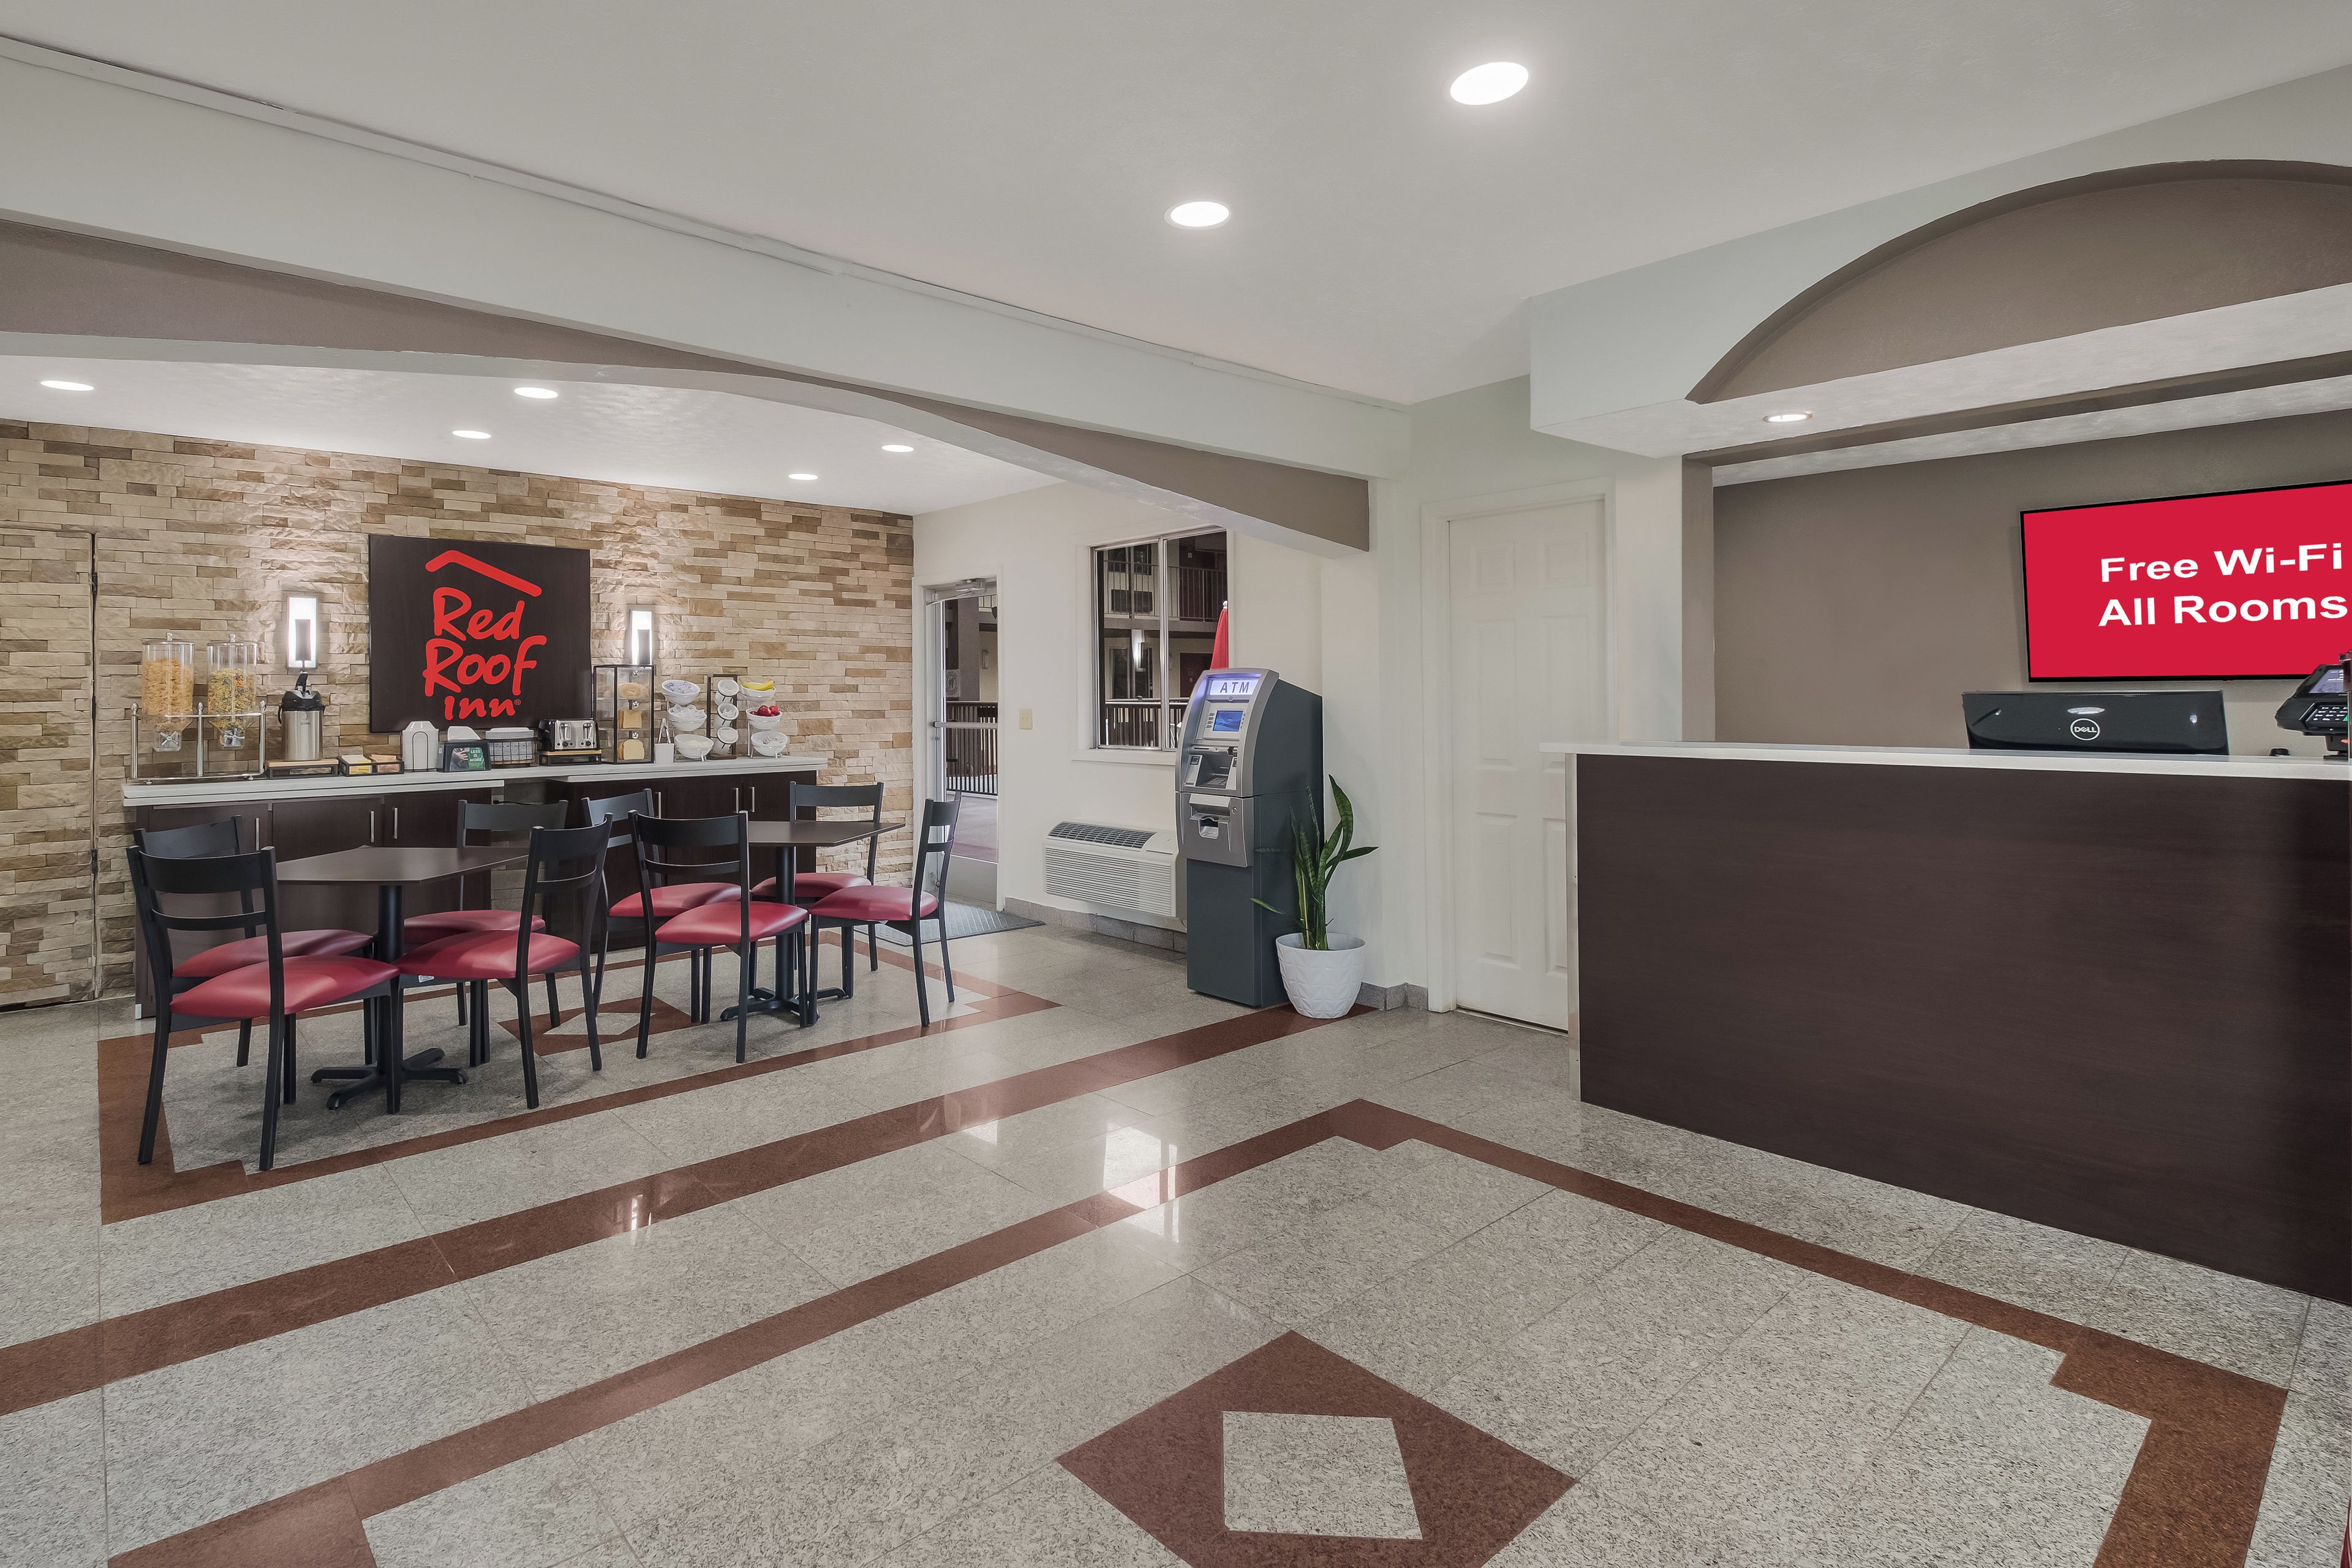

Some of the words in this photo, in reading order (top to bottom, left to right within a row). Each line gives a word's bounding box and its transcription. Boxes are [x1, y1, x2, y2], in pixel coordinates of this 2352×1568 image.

[2101, 557, 2199, 582] Free
[2214, 542, 2343, 576] Wi-Fi
[432, 586, 525, 641] Red
[2098, 598, 2156, 627] All
[2174, 595, 2348, 624] Rooms
[422, 635, 548, 697] Roof
[1219, 682, 1250, 693] ATM
